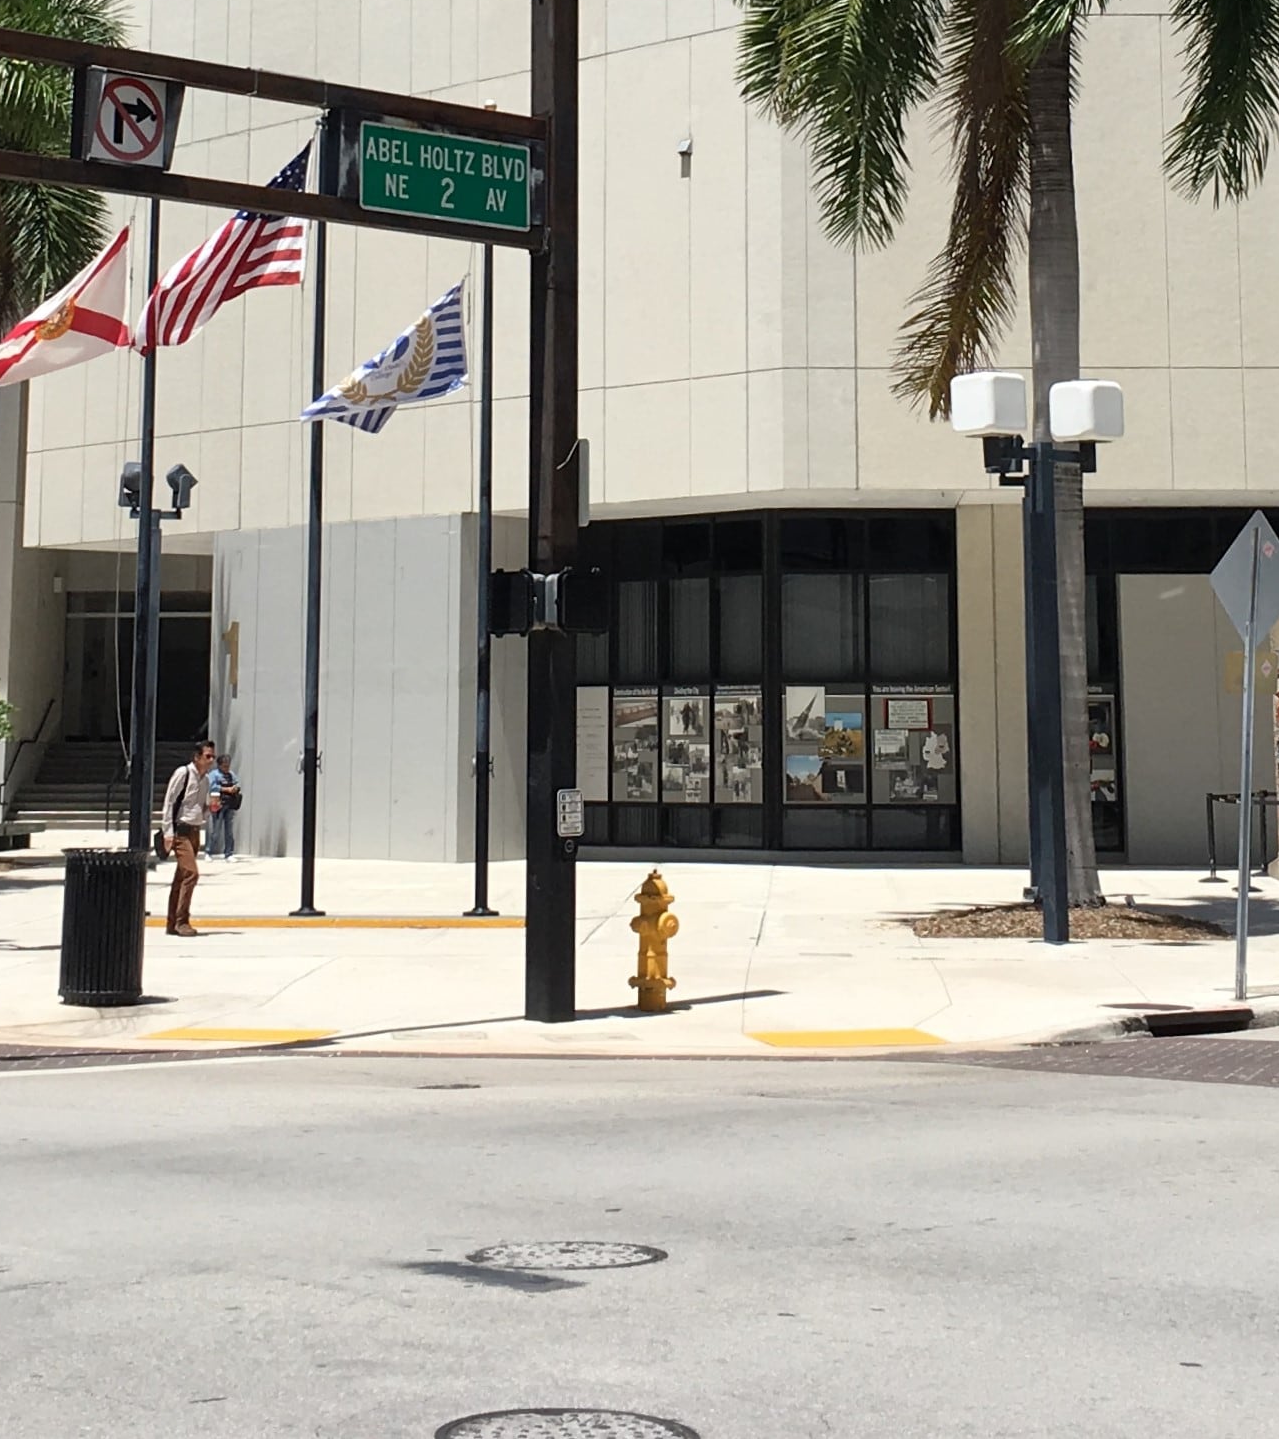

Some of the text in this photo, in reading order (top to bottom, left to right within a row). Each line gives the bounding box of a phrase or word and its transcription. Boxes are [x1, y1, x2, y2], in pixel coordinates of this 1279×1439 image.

[366, 136, 525, 182] ABEL HOLTZ BLVD
[385, 172, 507, 212] NE 2 AV
